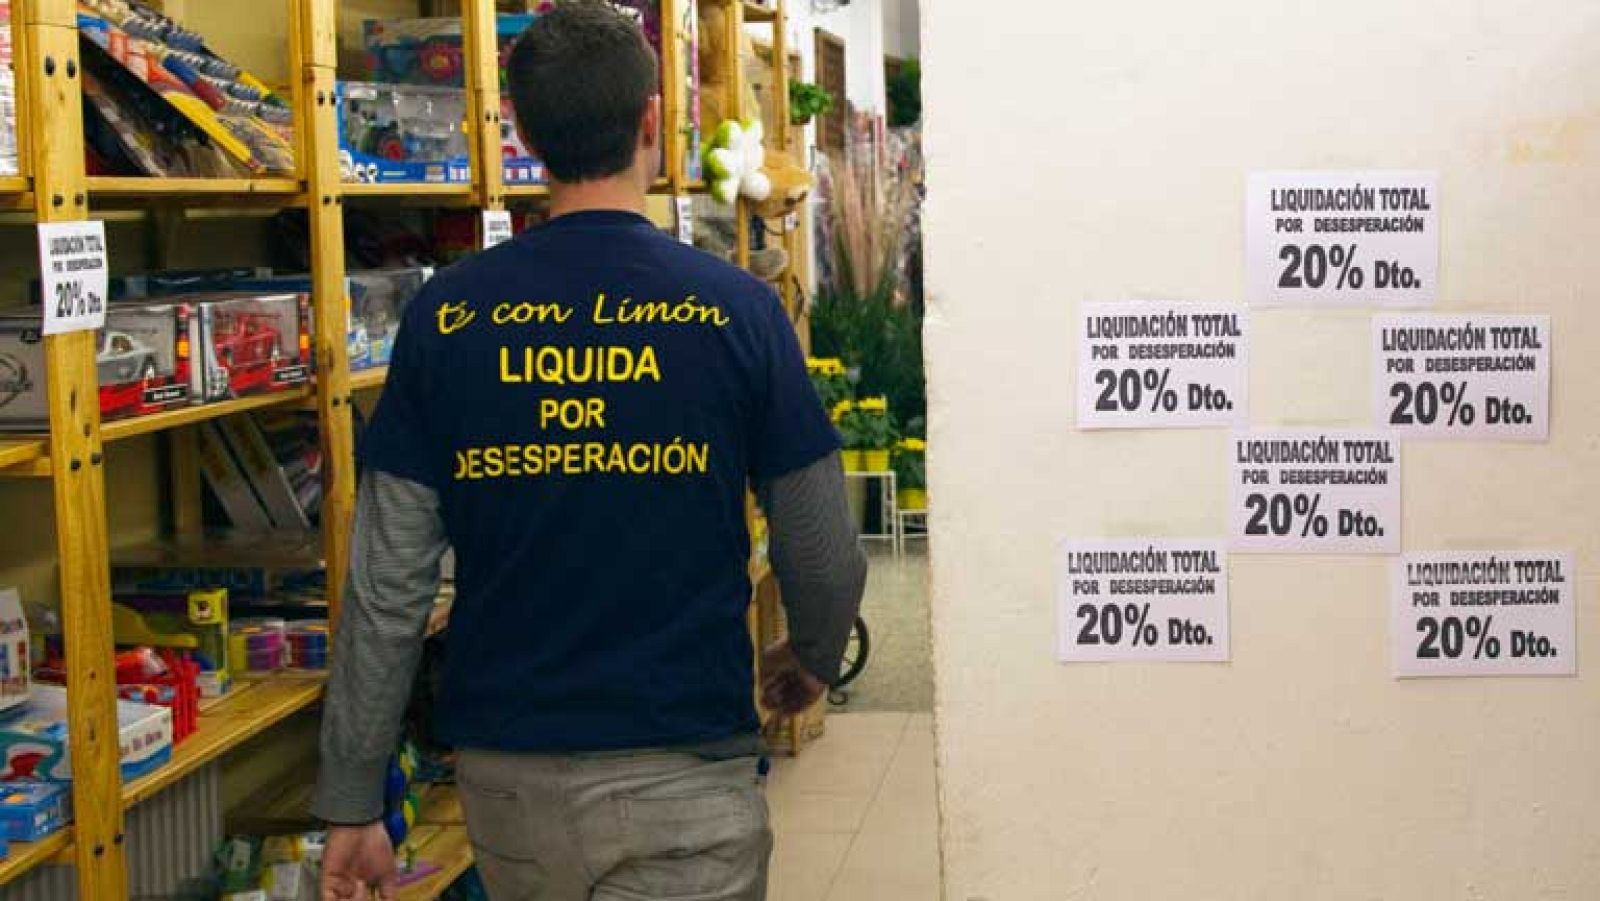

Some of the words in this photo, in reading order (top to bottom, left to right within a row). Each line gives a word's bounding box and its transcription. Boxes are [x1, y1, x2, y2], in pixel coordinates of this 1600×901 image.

[1271, 184, 1375, 212] LIQUIDACIÓN
[1379, 188, 1430, 211] TOTAL
[1274, 216, 1304, 234] POR
[1313, 213, 1424, 233] DESESPERACIÓN
[1278, 244, 1364, 290] 20%
[1375, 261, 1421, 288] Dto.
[491, 301, 574, 325] con
[592, 292, 731, 327] Limón
[1087, 310, 1188, 340] LIQUIDACIÓN
[1192, 313, 1241, 337] TOTAL
[1383, 322, 1485, 352] LIQUIDACIÓN
[1490, 327, 1542, 350] TOTAL
[499, 345, 661, 385] LIQUIDA
[1091, 343, 1120, 361] POR
[1128, 339, 1236, 360] DESESPERACIÓN
[1386, 357, 1416, 374] POR
[1424, 352, 1536, 374] DESESPERACIÓN
[1096, 367, 1177, 413] 20%
[1188, 384, 1233, 411] Dto.
[1389, 381, 1475, 426] 20%
[1486, 396, 1532, 424] Dto.
[540, 397, 606, 430] POR
[1237, 436, 1339, 463] LIQUIDACIÓN
[1343, 440, 1394, 463] TOTAL
[1241, 468, 1270, 485] POR
[1280, 466, 1388, 485] DESESPERACIÓN
[1245, 494, 1328, 538] 20%
[1339, 509, 1383, 536] Dto.
[1069, 545, 1167, 574] LIQUIDACIÓN
[1171, 551, 1220, 573] TOTAL
[1408, 556, 1510, 586] LIQUIDACIÓN
[1514, 561, 1564, 584] TOTAL
[1072, 579, 1101, 596] POR
[1109, 575, 1216, 596] DESESPERACIÓN
[1412, 591, 1441, 608] POR
[1449, 585, 1560, 607] DESESPERACIÓN
[1077, 603, 1158, 646] 20%
[1168, 618, 1212, 645] Dto.
[1417, 615, 1500, 659] 20%
[1511, 630, 1556, 657] Dto.
